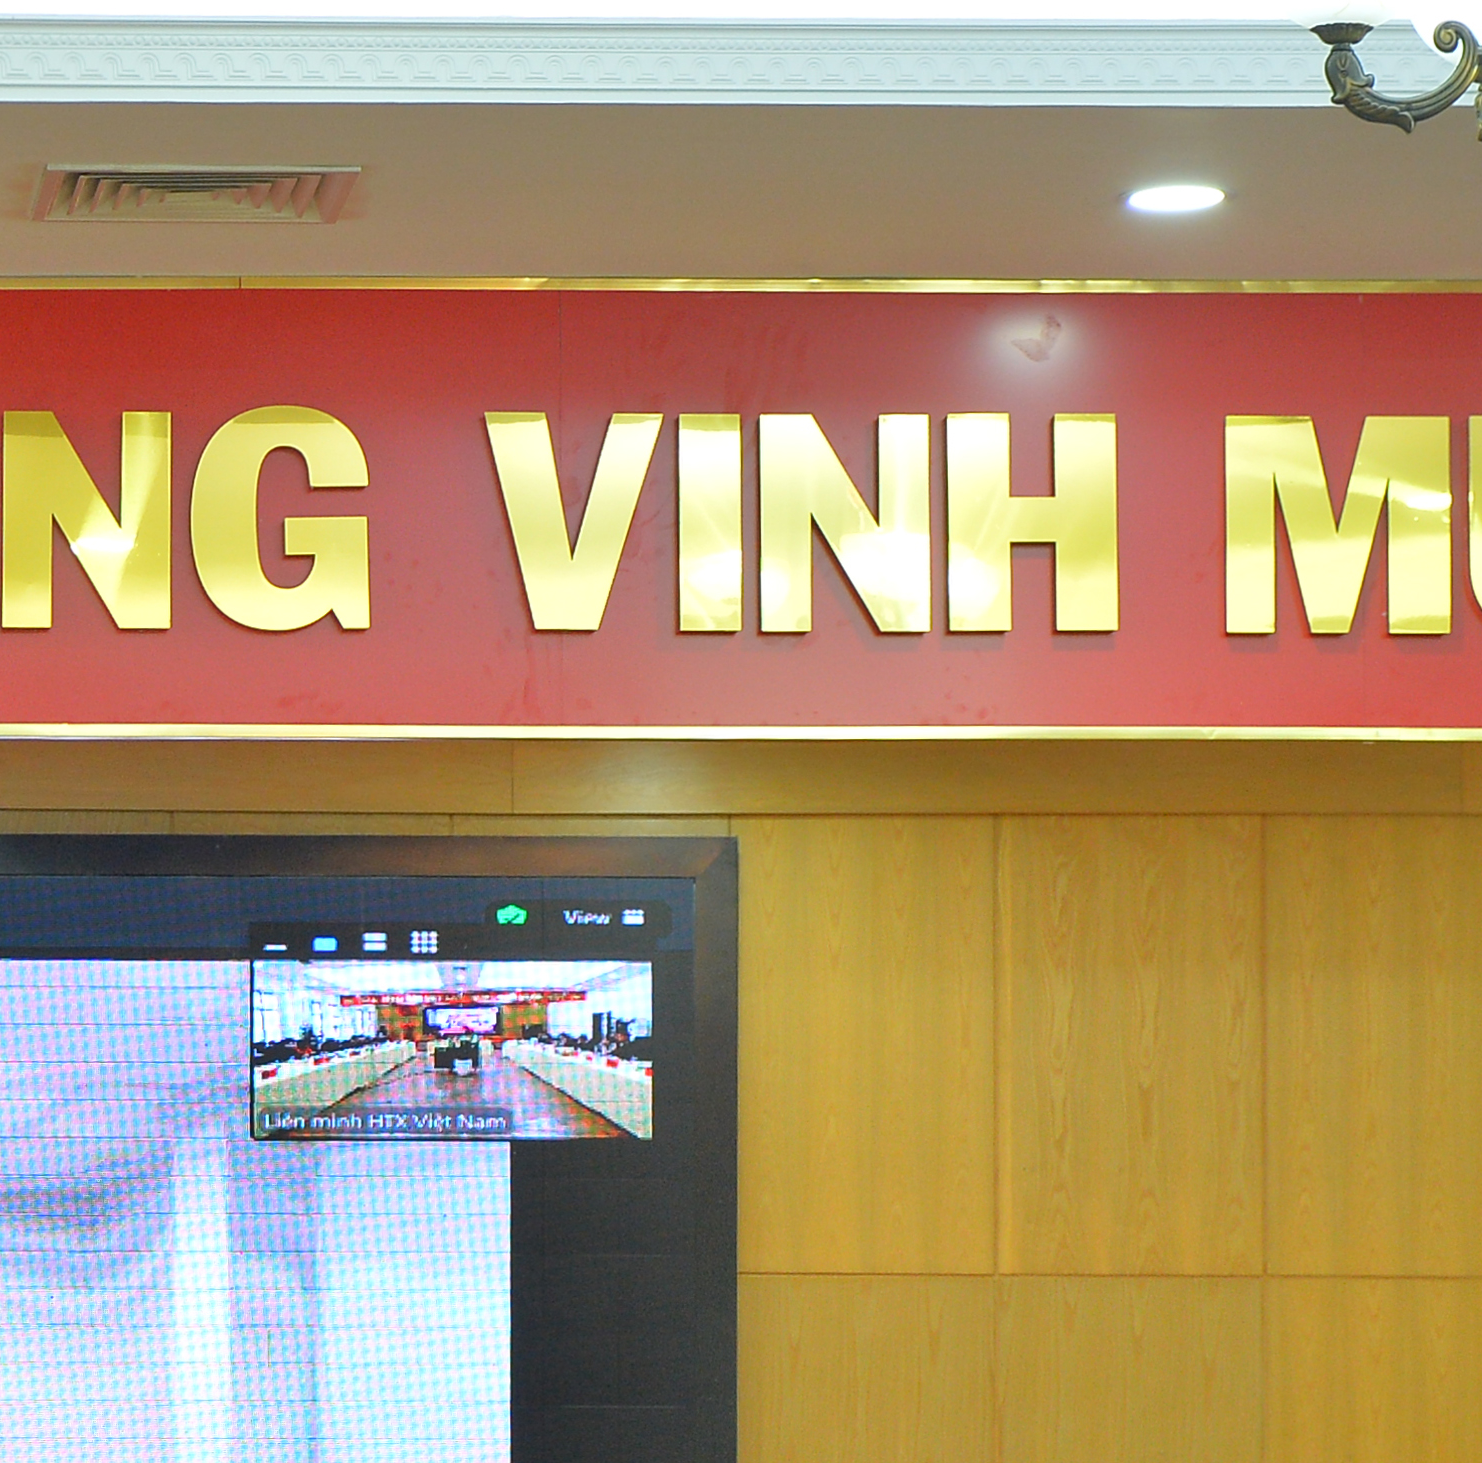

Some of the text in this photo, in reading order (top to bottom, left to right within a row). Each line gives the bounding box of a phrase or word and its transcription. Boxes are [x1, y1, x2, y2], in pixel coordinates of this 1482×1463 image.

[485, 411, 1119, 634] VINH
[563, 910, 612, 925] View
[311, 1113, 362, 1129] minh
[369, 1113, 408, 1129] HTX
[457, 1113, 507, 1129] Nam
